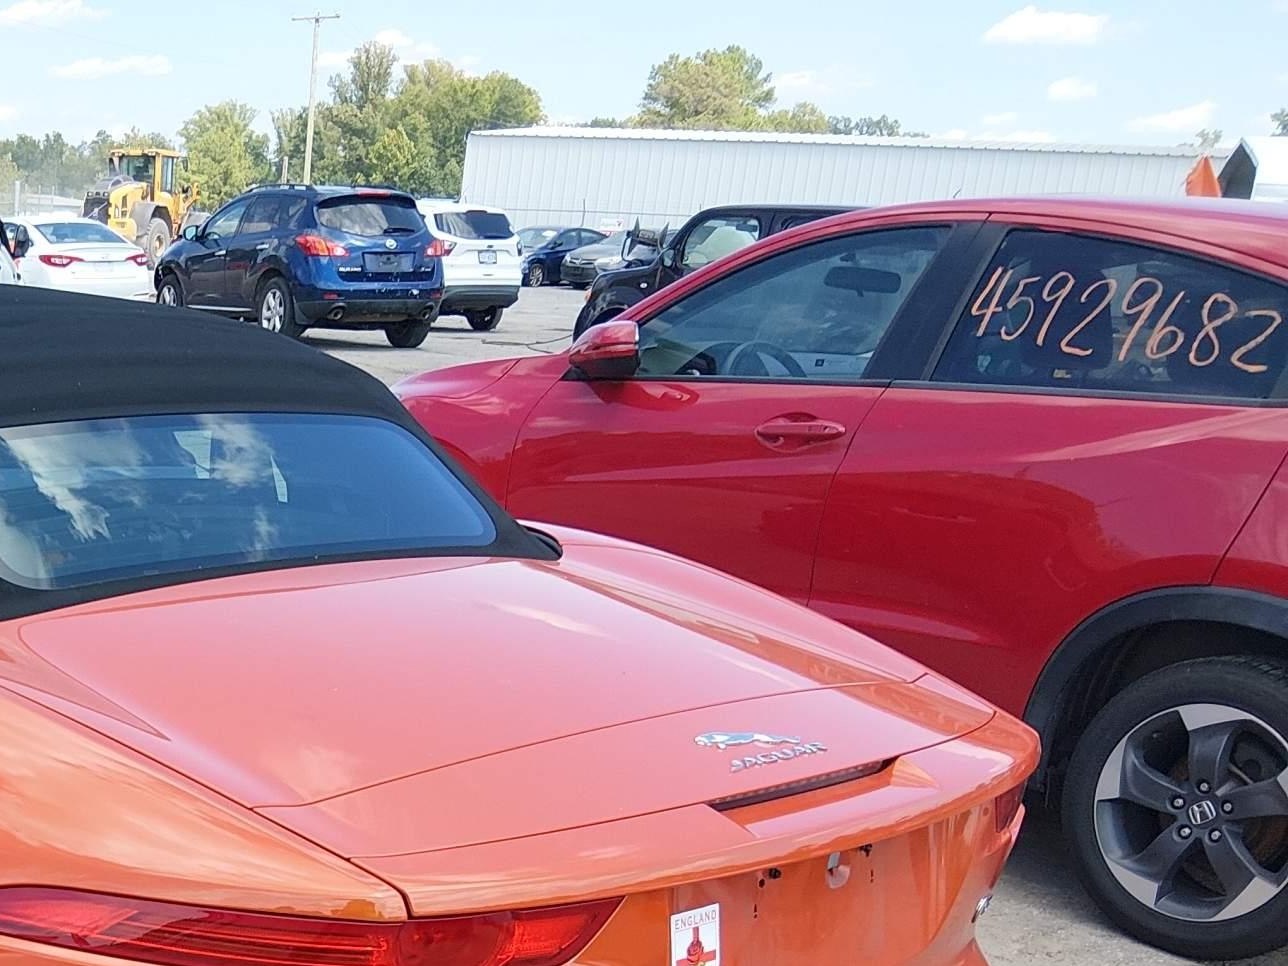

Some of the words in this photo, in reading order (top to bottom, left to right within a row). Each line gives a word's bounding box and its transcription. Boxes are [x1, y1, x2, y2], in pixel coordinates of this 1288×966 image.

[971, 266, 1282, 374] 45929682
[730, 742, 827, 772] JAGUAR
[674, 909, 717, 930] ENGLAND
